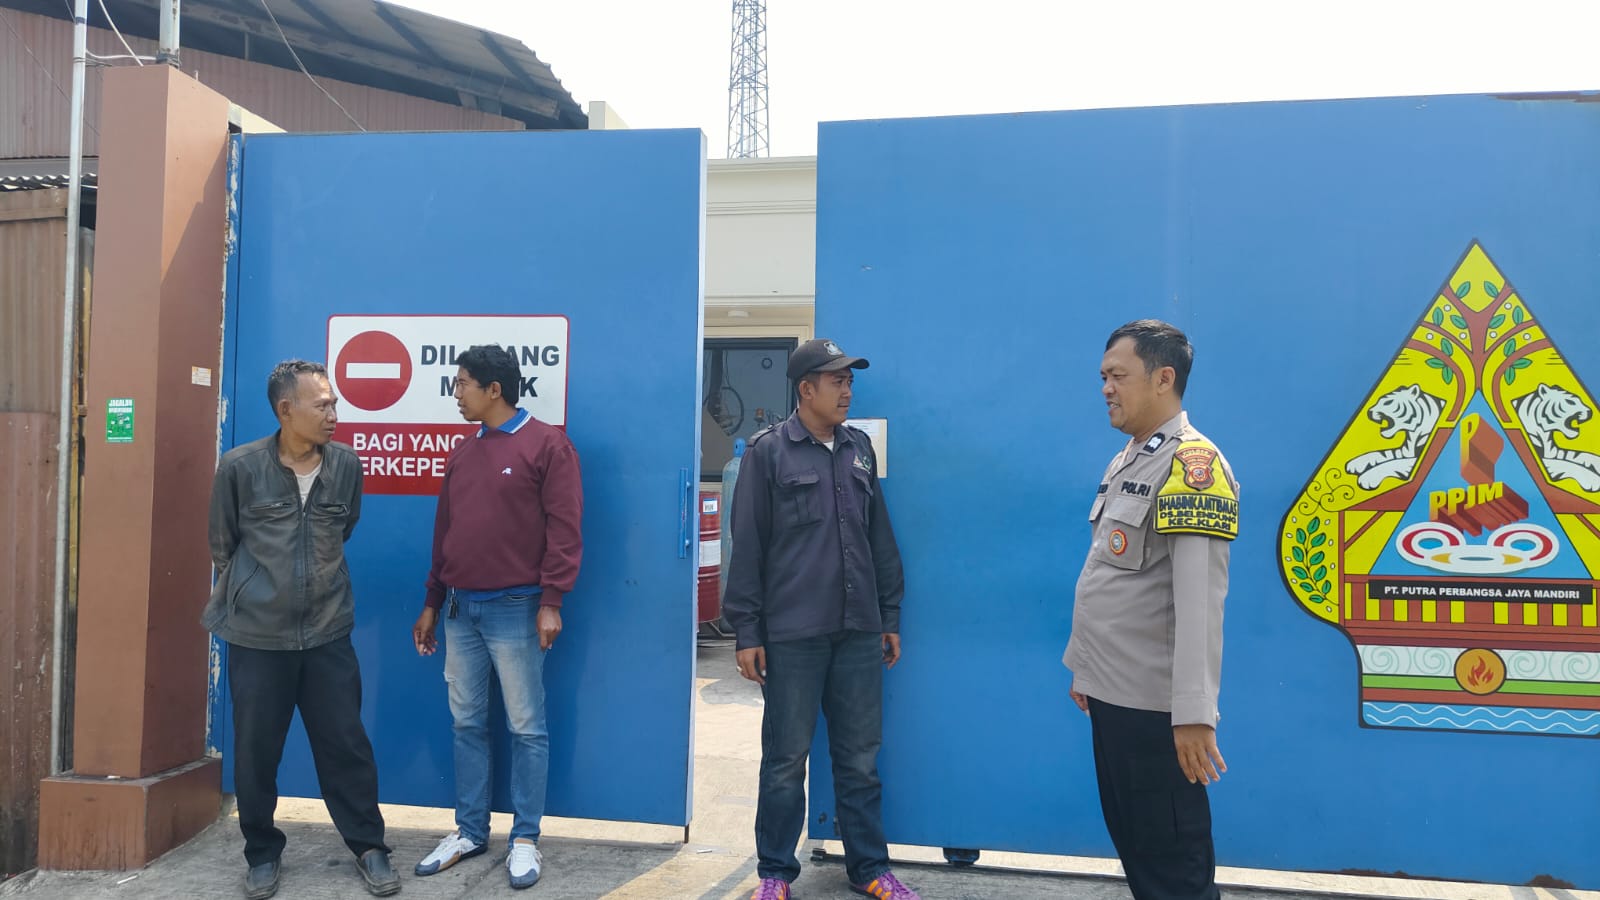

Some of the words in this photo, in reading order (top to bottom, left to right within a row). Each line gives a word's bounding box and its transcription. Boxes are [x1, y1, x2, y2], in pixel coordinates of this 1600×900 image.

[353, 433, 403, 451] BAGI
[1121, 481, 1151, 496] POLRI
[1159, 496, 1237, 516] BHABINKAMTIBMAS
[1429, 481, 1503, 521] PPJM
[1384, 586, 1399, 595] PT.
[1402, 586, 1436, 595] PUTRA
[1439, 587, 1502, 597] PERBANGSA
[1505, 588, 1532, 598] JAYA
[1534, 589, 1579, 599] MANDIRI
